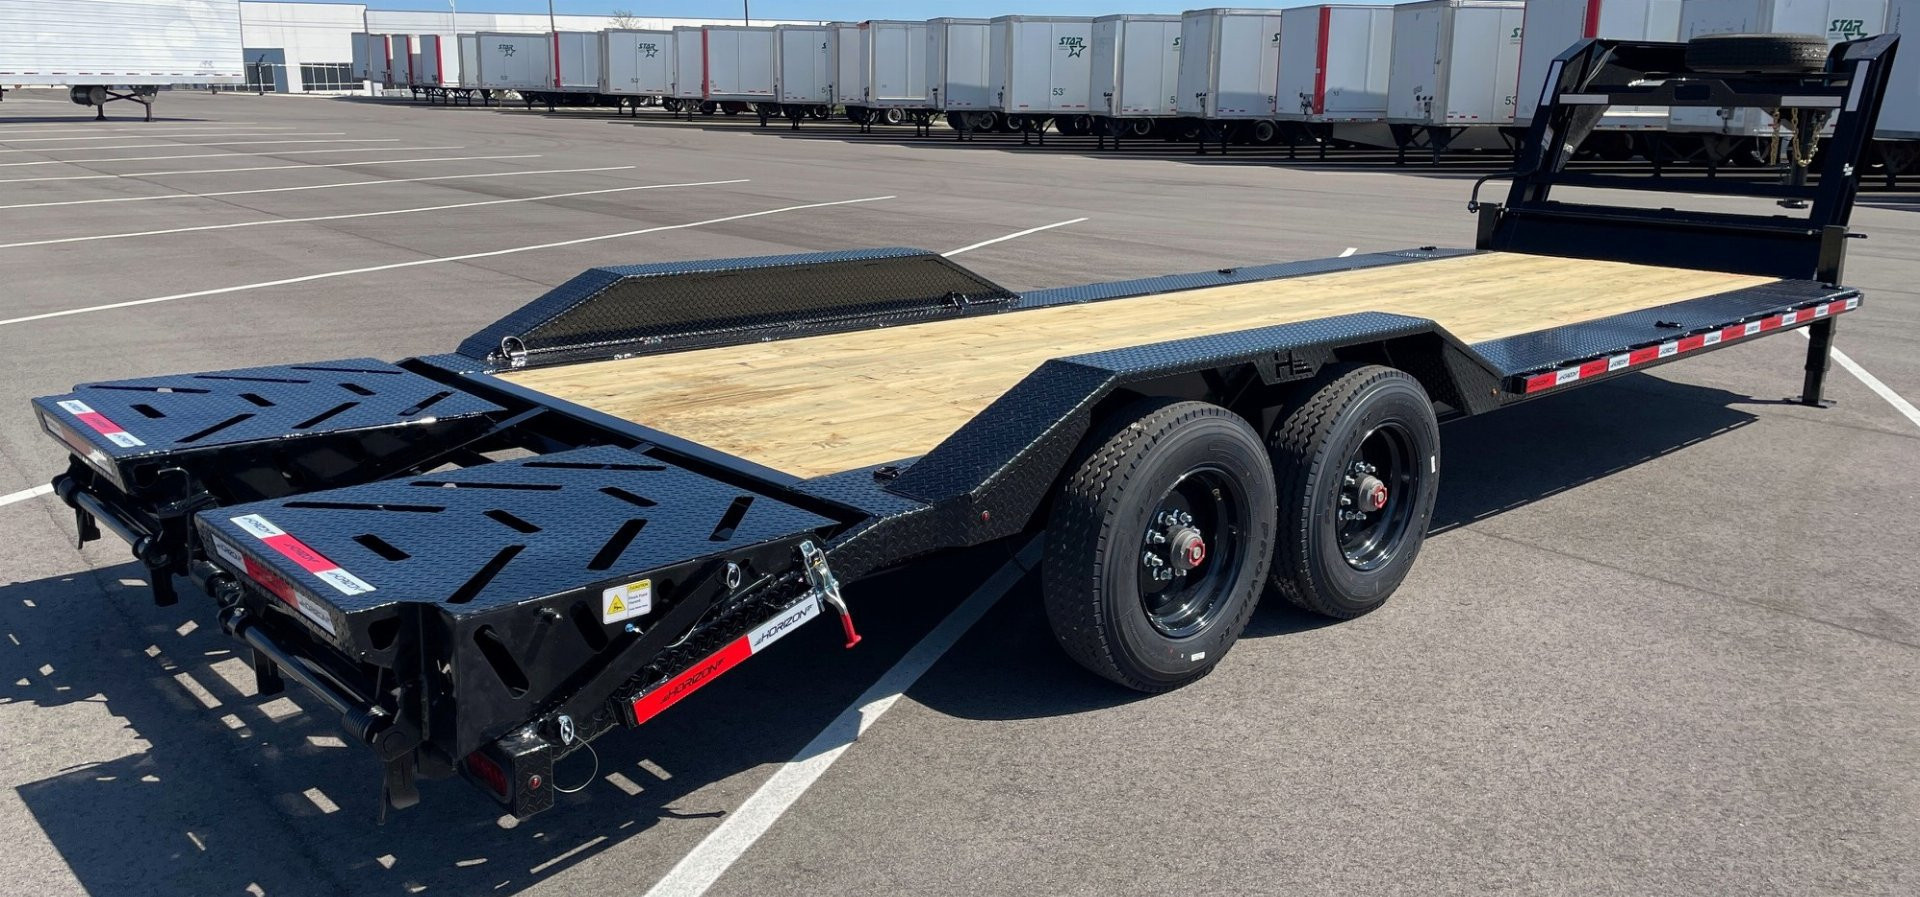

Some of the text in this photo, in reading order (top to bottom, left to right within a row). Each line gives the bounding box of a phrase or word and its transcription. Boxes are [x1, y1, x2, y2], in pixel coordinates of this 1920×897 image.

[1829, 19, 1864, 32] STAR
[1059, 36, 1083, 45] STAR
[758, 605, 811, 646] HORIZON
[662, 658, 722, 703] HORIZON
